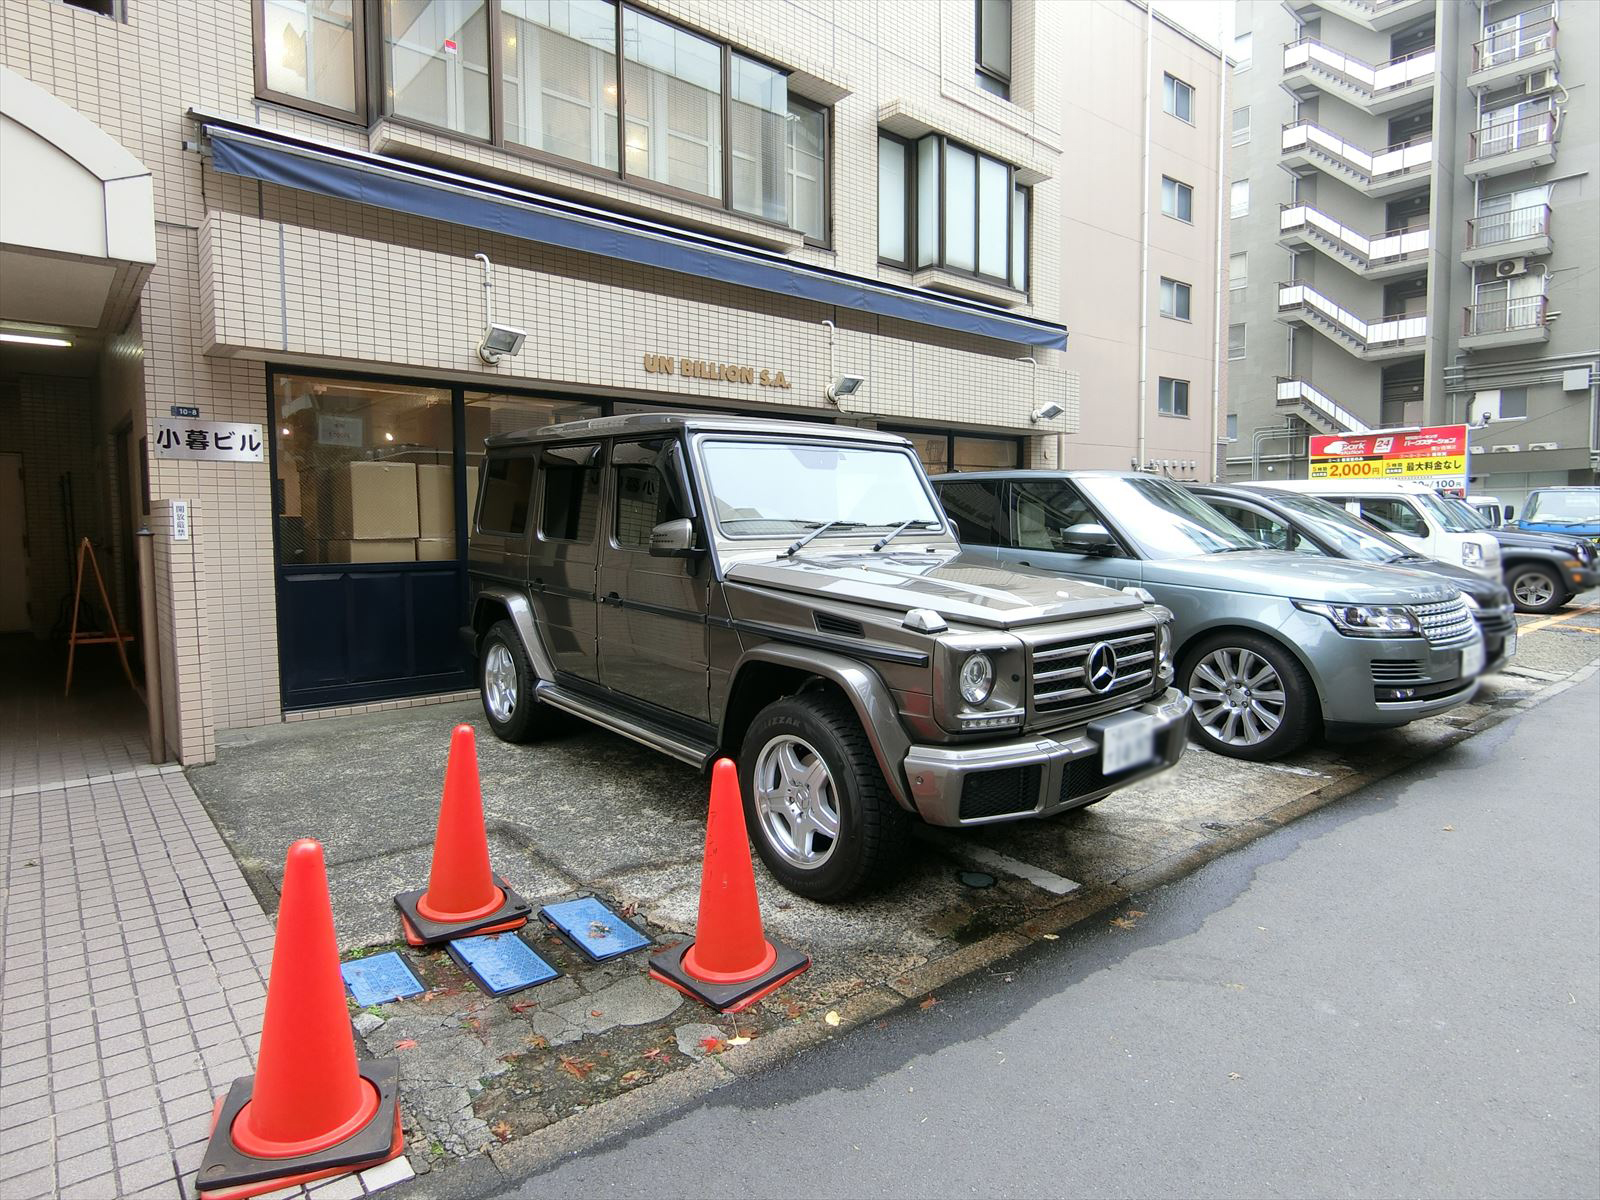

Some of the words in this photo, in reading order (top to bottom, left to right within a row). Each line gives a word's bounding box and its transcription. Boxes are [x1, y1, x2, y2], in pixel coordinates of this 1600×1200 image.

[644, 353, 674, 375] UN
[681, 358, 754, 385] BILLION
[760, 369, 792, 390] S.A.
[179, 408, 197, 416] 10-8
[156, 428, 261, 452] 小暮ビル
[1406, 460, 1462, 472] 最大料金なし
